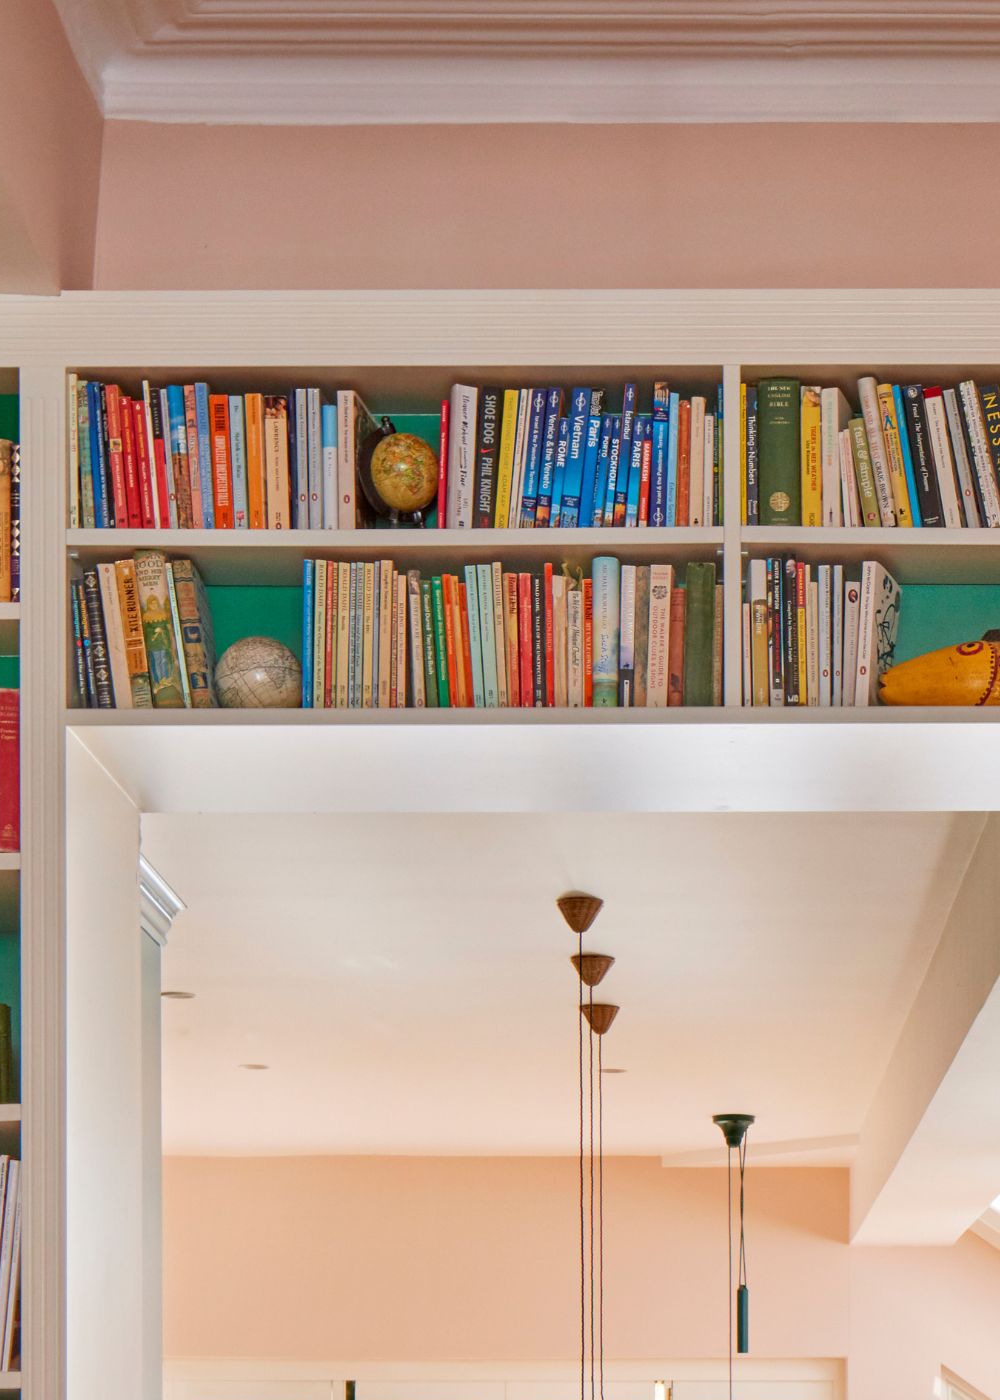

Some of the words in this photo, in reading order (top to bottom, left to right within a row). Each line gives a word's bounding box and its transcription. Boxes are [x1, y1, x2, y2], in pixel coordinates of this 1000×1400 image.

[484, 394, 496, 421] SHOE
[866, 410, 874, 425] AND
[911, 403, 920, 418] Freud
[483, 422, 495, 445] DOG
[546, 413, 557, 440] Venice
[570, 414, 585, 459] Vietnam
[588, 419, 601, 448] Paris
[747, 415, 756, 446] Thinking
[853, 426, 864, 449] fast
[545, 447, 554, 461] the
[556, 440, 567, 468] ROME
[602, 435, 610, 458] PORTO
[632, 440, 642, 468] PARIS
[857, 449, 867, 460] &
[915, 432, 927, 466] Interpretation
[481, 457, 493, 477] PHIL
[542, 462, 553, 489] Veneto
[608, 438, 620, 491] STOCKHOLM
[641, 442, 651, 482] MARRAKESH
[748, 451, 756, 486] Numbers
[875, 461, 886, 482] CRAIG
[859, 462, 873, 499] simple
[922, 472, 930, 492] Dreams
[479, 478, 492, 513] KNIGHT
[879, 483, 890, 509] BROWN
[123, 577, 137, 612] RUNNER
[127, 614, 139, 633] KITE
[651, 605, 659, 639] OUTDOOR
